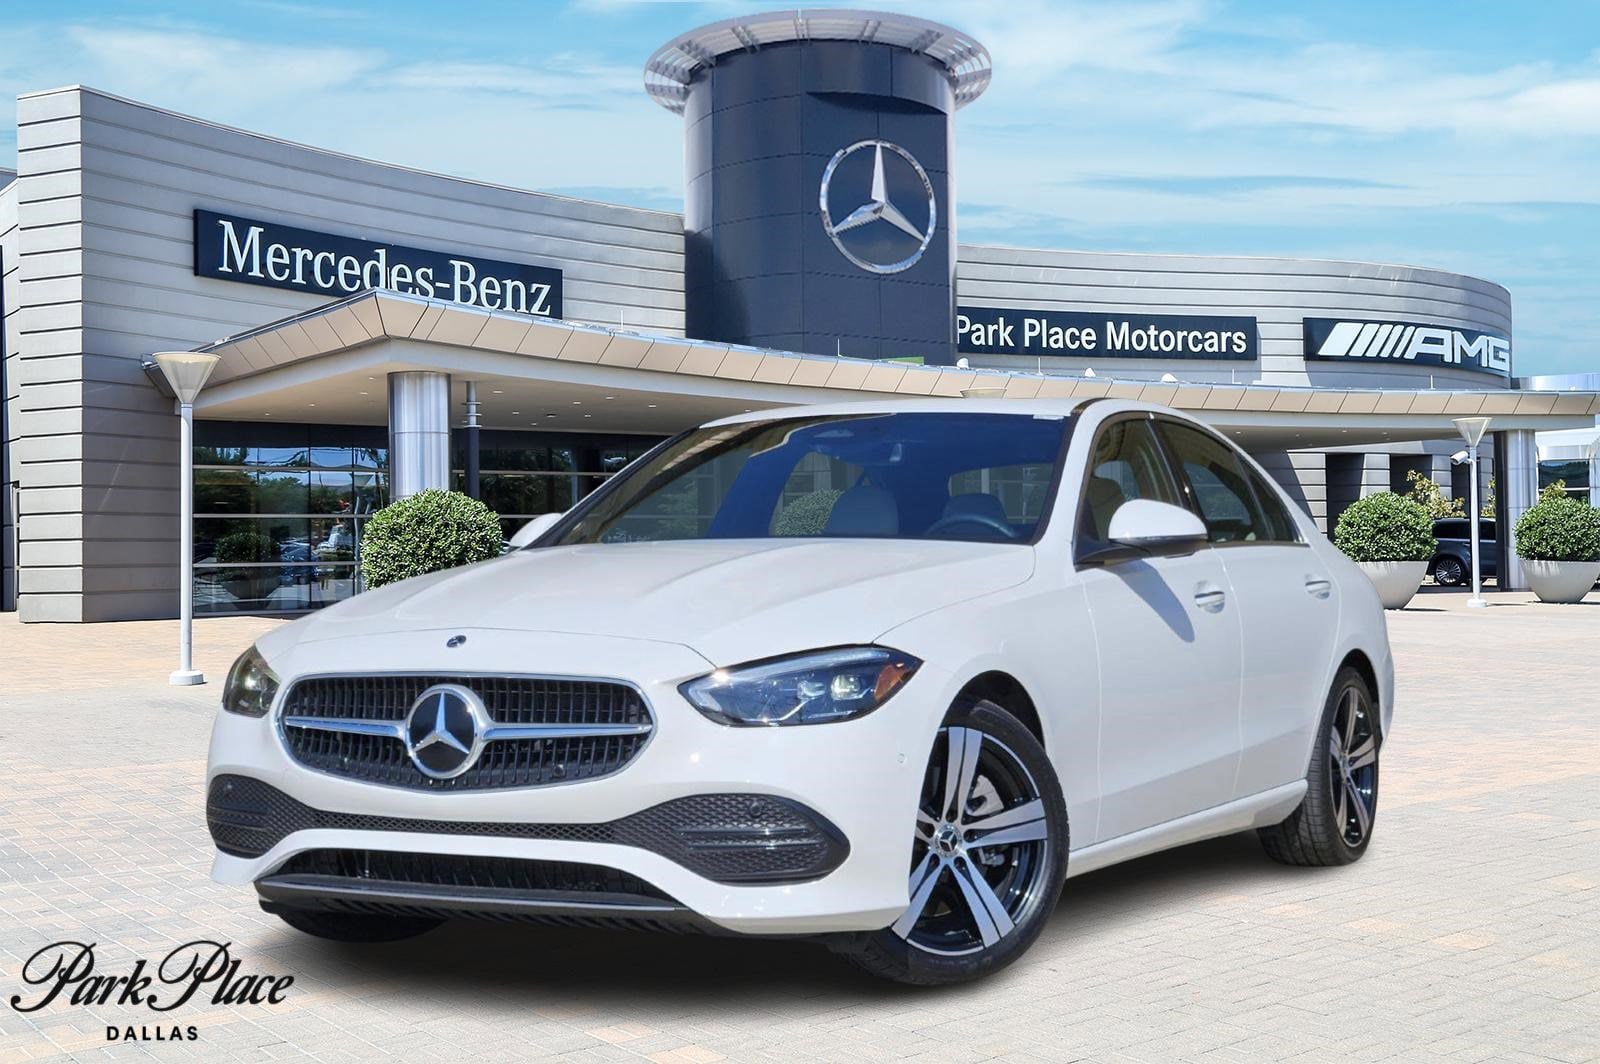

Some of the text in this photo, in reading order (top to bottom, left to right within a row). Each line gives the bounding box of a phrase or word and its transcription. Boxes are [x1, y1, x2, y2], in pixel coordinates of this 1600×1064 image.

[217, 220, 552, 317] Mercedes-Benz
[956, 315, 1247, 353] Park Place Motorcars
[1403, 326, 1510, 372] AMG
